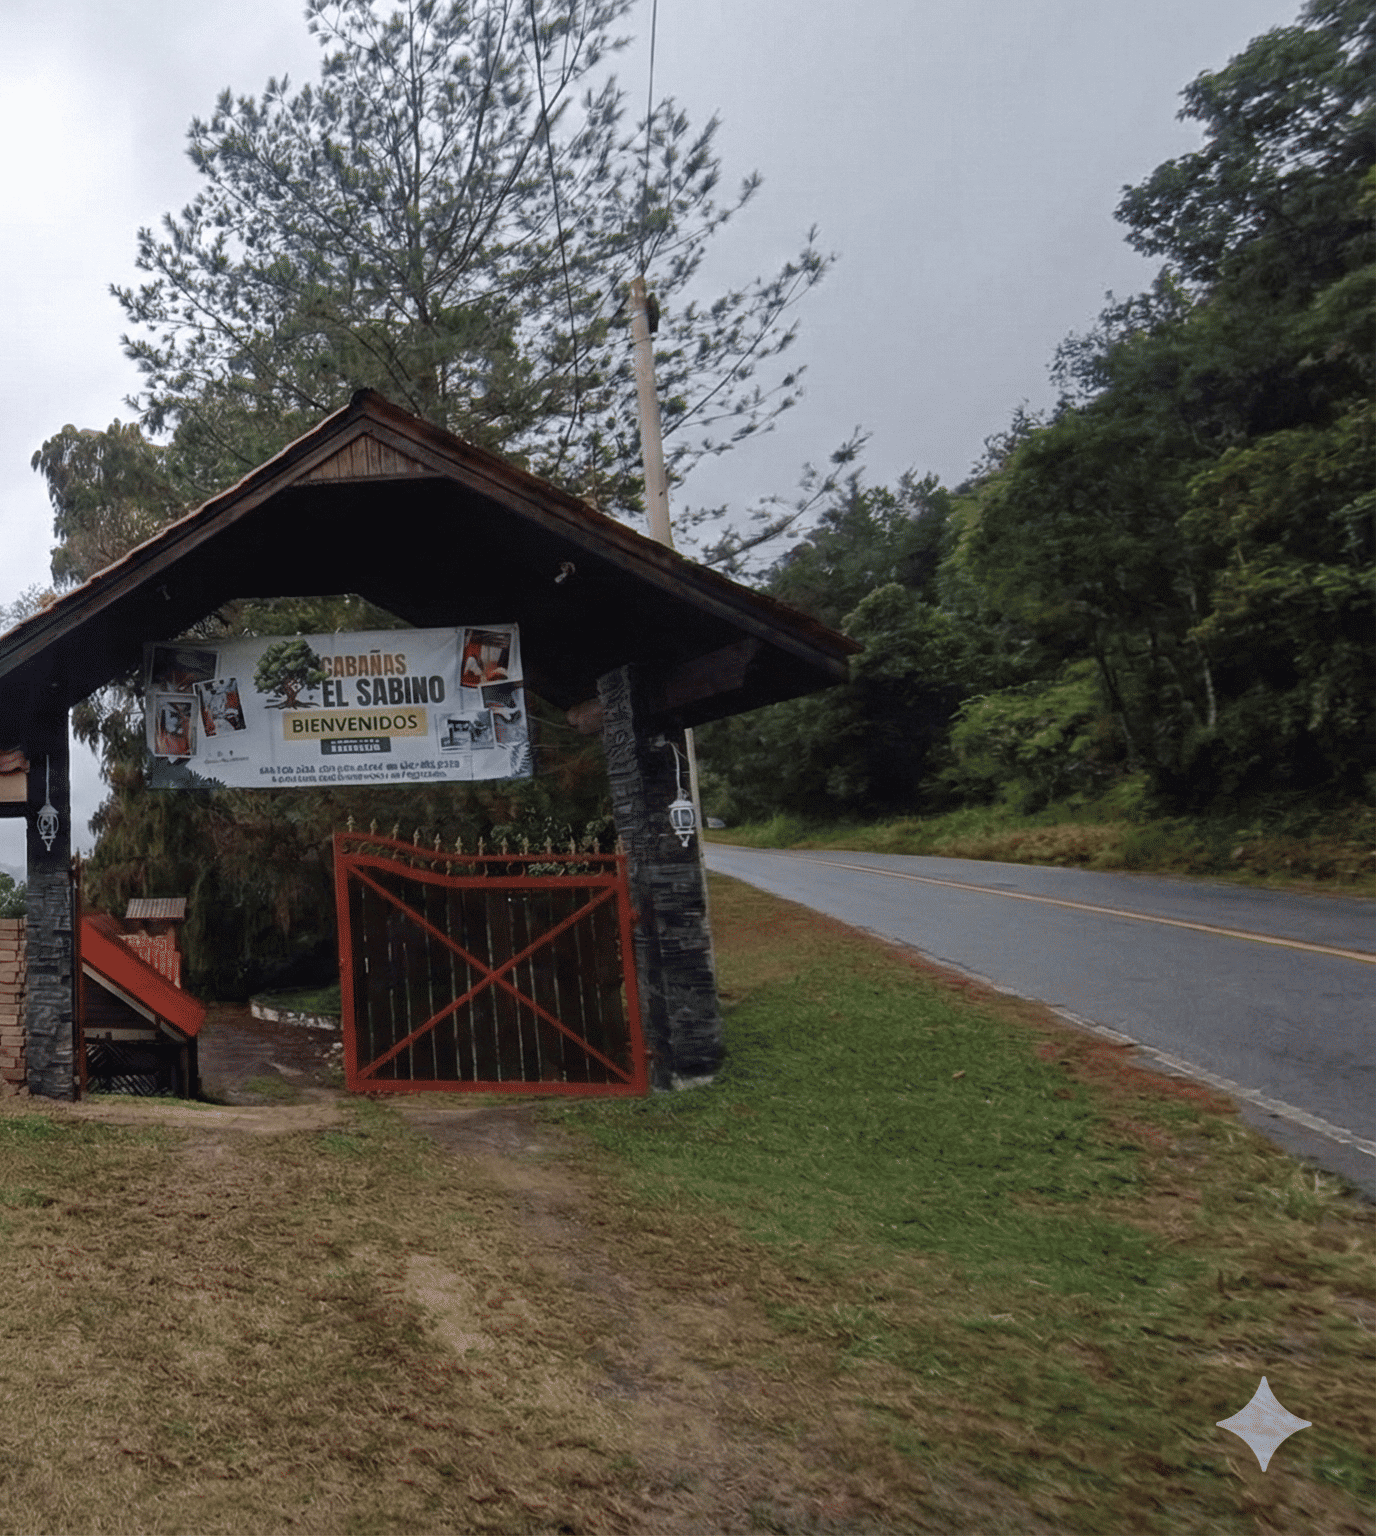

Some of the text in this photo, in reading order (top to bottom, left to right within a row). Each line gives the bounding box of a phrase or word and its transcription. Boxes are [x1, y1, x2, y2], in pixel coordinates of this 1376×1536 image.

[321, 650, 407, 677] CABAÑAS
[322, 675, 445, 707] EL SABINO
[293, 715, 418, 733] BIENVENIDOS
